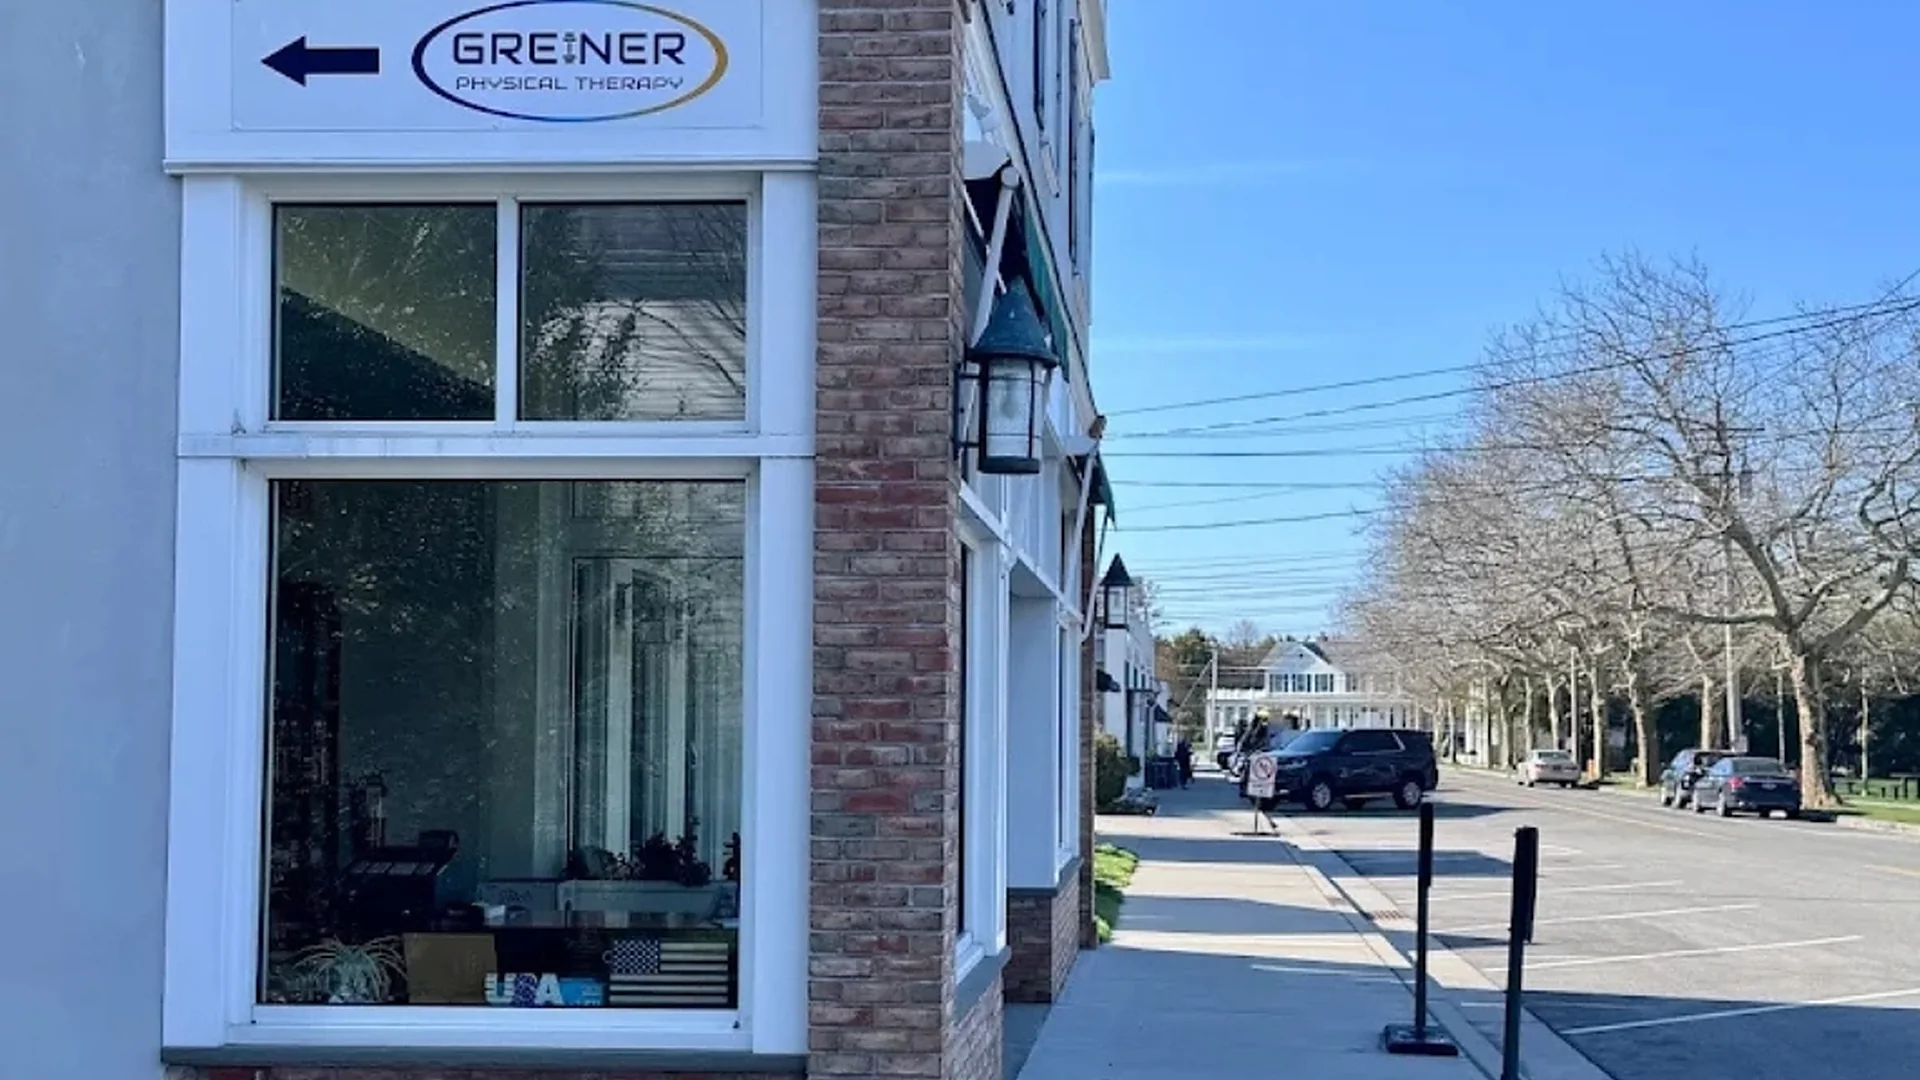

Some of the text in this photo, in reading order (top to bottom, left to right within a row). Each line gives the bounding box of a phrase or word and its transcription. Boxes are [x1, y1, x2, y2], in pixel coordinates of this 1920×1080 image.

[453, 32, 685, 65] GREINER
[456, 76, 684, 90] PHYSICAL THERAPY
[484, 972, 564, 1006] USA
